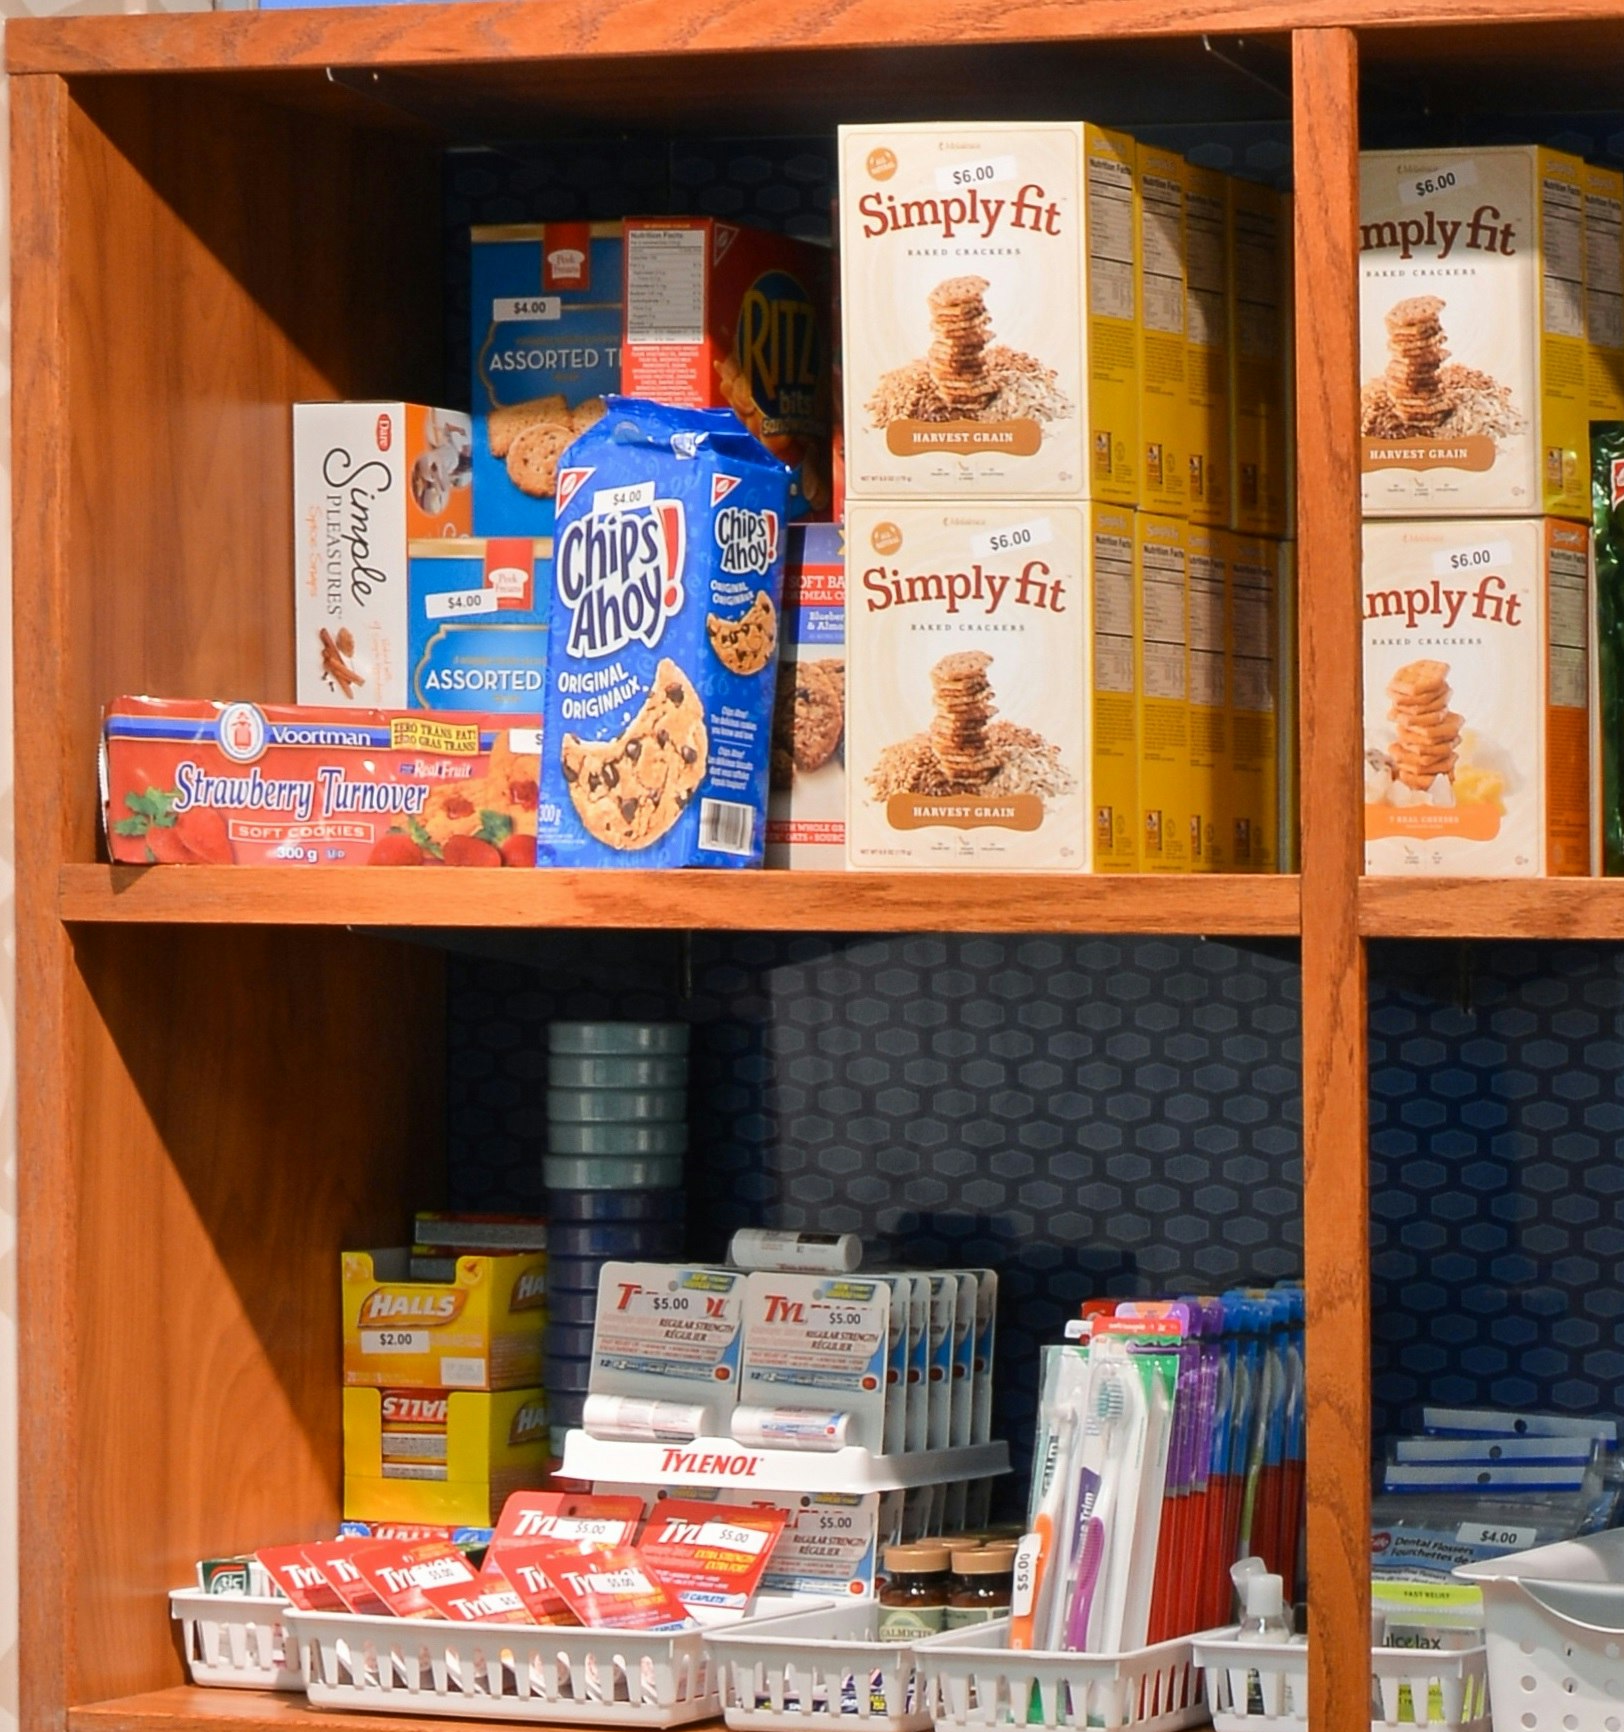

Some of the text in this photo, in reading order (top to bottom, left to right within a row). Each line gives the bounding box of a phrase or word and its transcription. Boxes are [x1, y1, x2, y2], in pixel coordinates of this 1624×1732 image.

[953, 166, 994, 185] $6.00
[1416, 172, 1456, 197] $6.00
[859, 185, 1061, 238] Simply fit
[1466, 206, 1516, 256] fit
[956, 248, 1022, 256] CRACKERS
[513, 302, 546, 314] $4.00
[742, 289, 817, 398] RITZ
[490, 349, 598, 371] ASSORTED
[913, 432, 1013, 443] HARVEST GRAIN
[1370, 448, 1468, 460] HARVEST GRAIN
[613, 491, 641, 506] $4.00
[323, 448, 392, 607] Simple
[718, 510, 766, 545] Chips
[990, 529, 1031, 551] $6.00
[327, 494, 342, 616] PLEASURES
[561, 515, 659, 601] Chips
[1450, 550, 1490, 569] $6.00
[863, 560, 1066, 614] Simply fit
[448, 595, 481, 609] $4.00
[1472, 576, 1522, 627] fit
[1372, 638, 1482, 646] BAKED CRACKERS
[425, 670, 542, 690] ASSORTED
[271, 726, 371, 747] Voortman
[175, 762, 427, 819] Strawberry Turnover
[913, 807, 1015, 818] HARVEST GRAIN
[238, 825, 281, 838] SOFT
[369, 1295, 455, 1318] HALLS
[653, 1298, 689, 1310] $5.00
[830, 1313, 861, 1324] $5.00
[379, 1334, 412, 1345] $2.00
[661, 1449, 758, 1476] TYLENOL
[820, 1517, 852, 1529] $5.00
[719, 1530, 748, 1543] $5.00
[1395, 1536, 1475, 1555] Dental Flossers
[1480, 1530, 1517, 1543] $4.00
[1388, 1547, 1454, 1565] Fourchettes
[1017, 1551, 1031, 1592] $5.00
